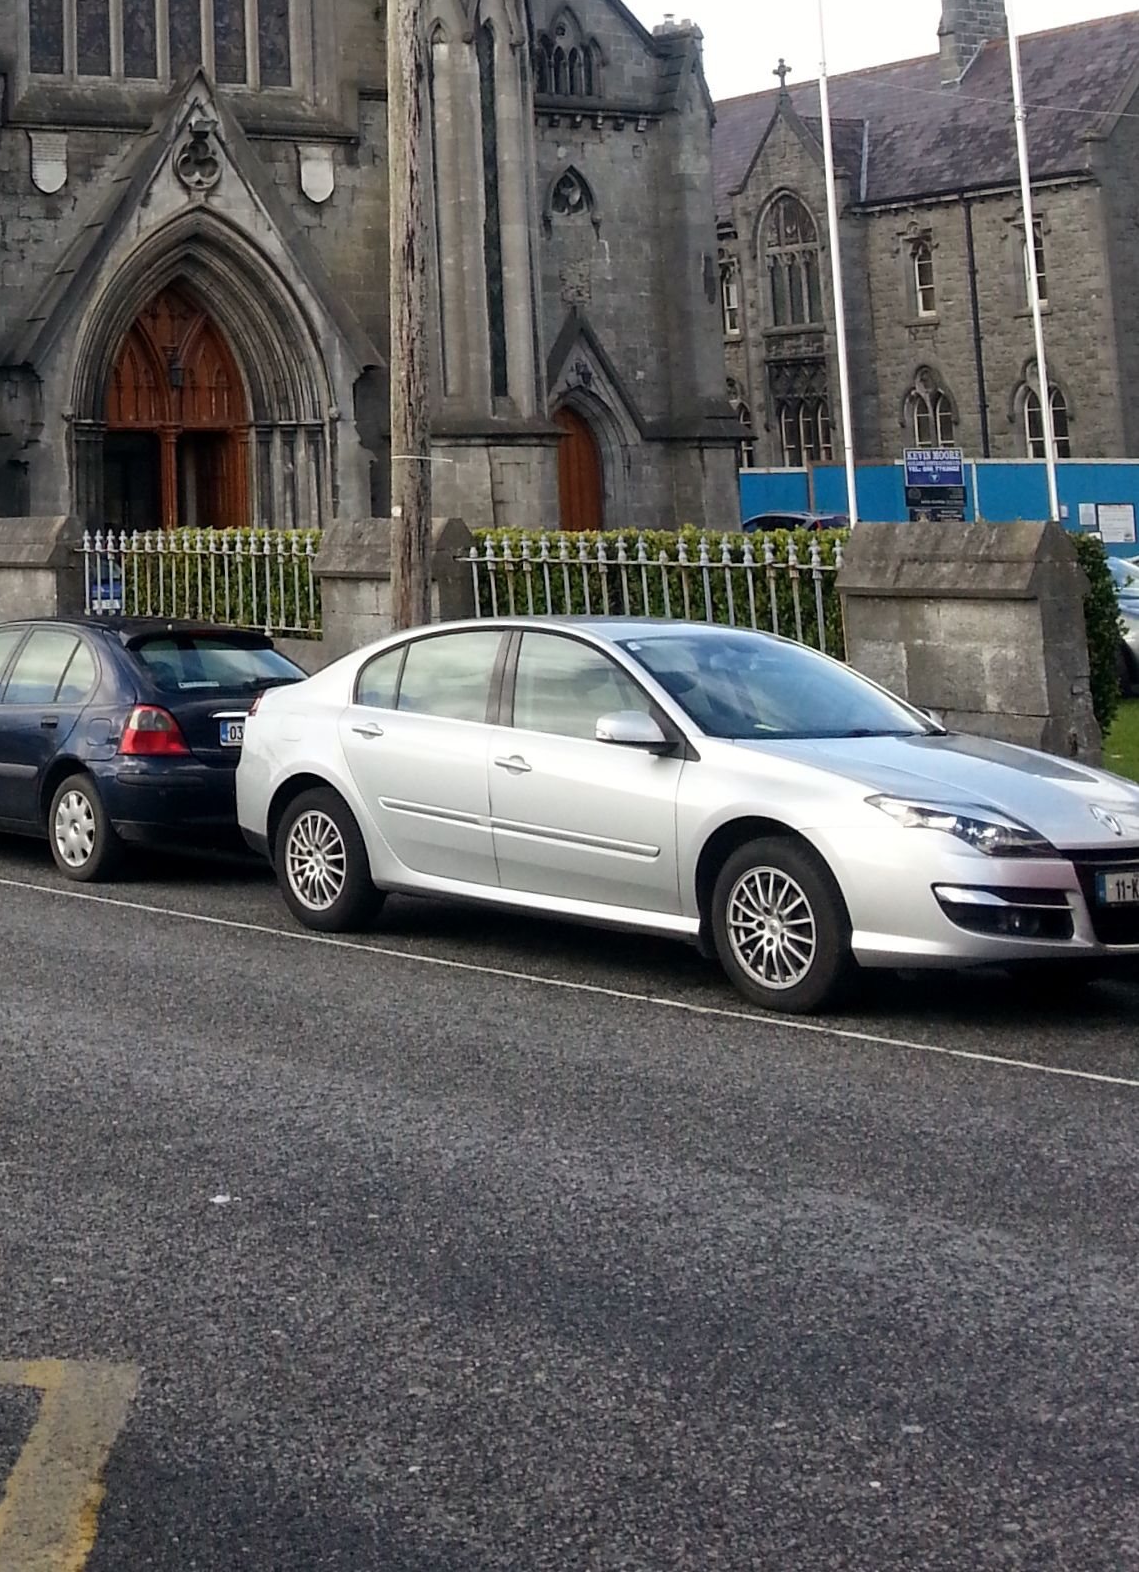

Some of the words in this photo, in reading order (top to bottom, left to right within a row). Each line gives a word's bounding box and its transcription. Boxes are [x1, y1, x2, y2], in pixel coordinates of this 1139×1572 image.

[906, 450, 931, 460] KEVIN
[932, 450, 960, 460] MOORE
[229, 725, 244, 740] 03
